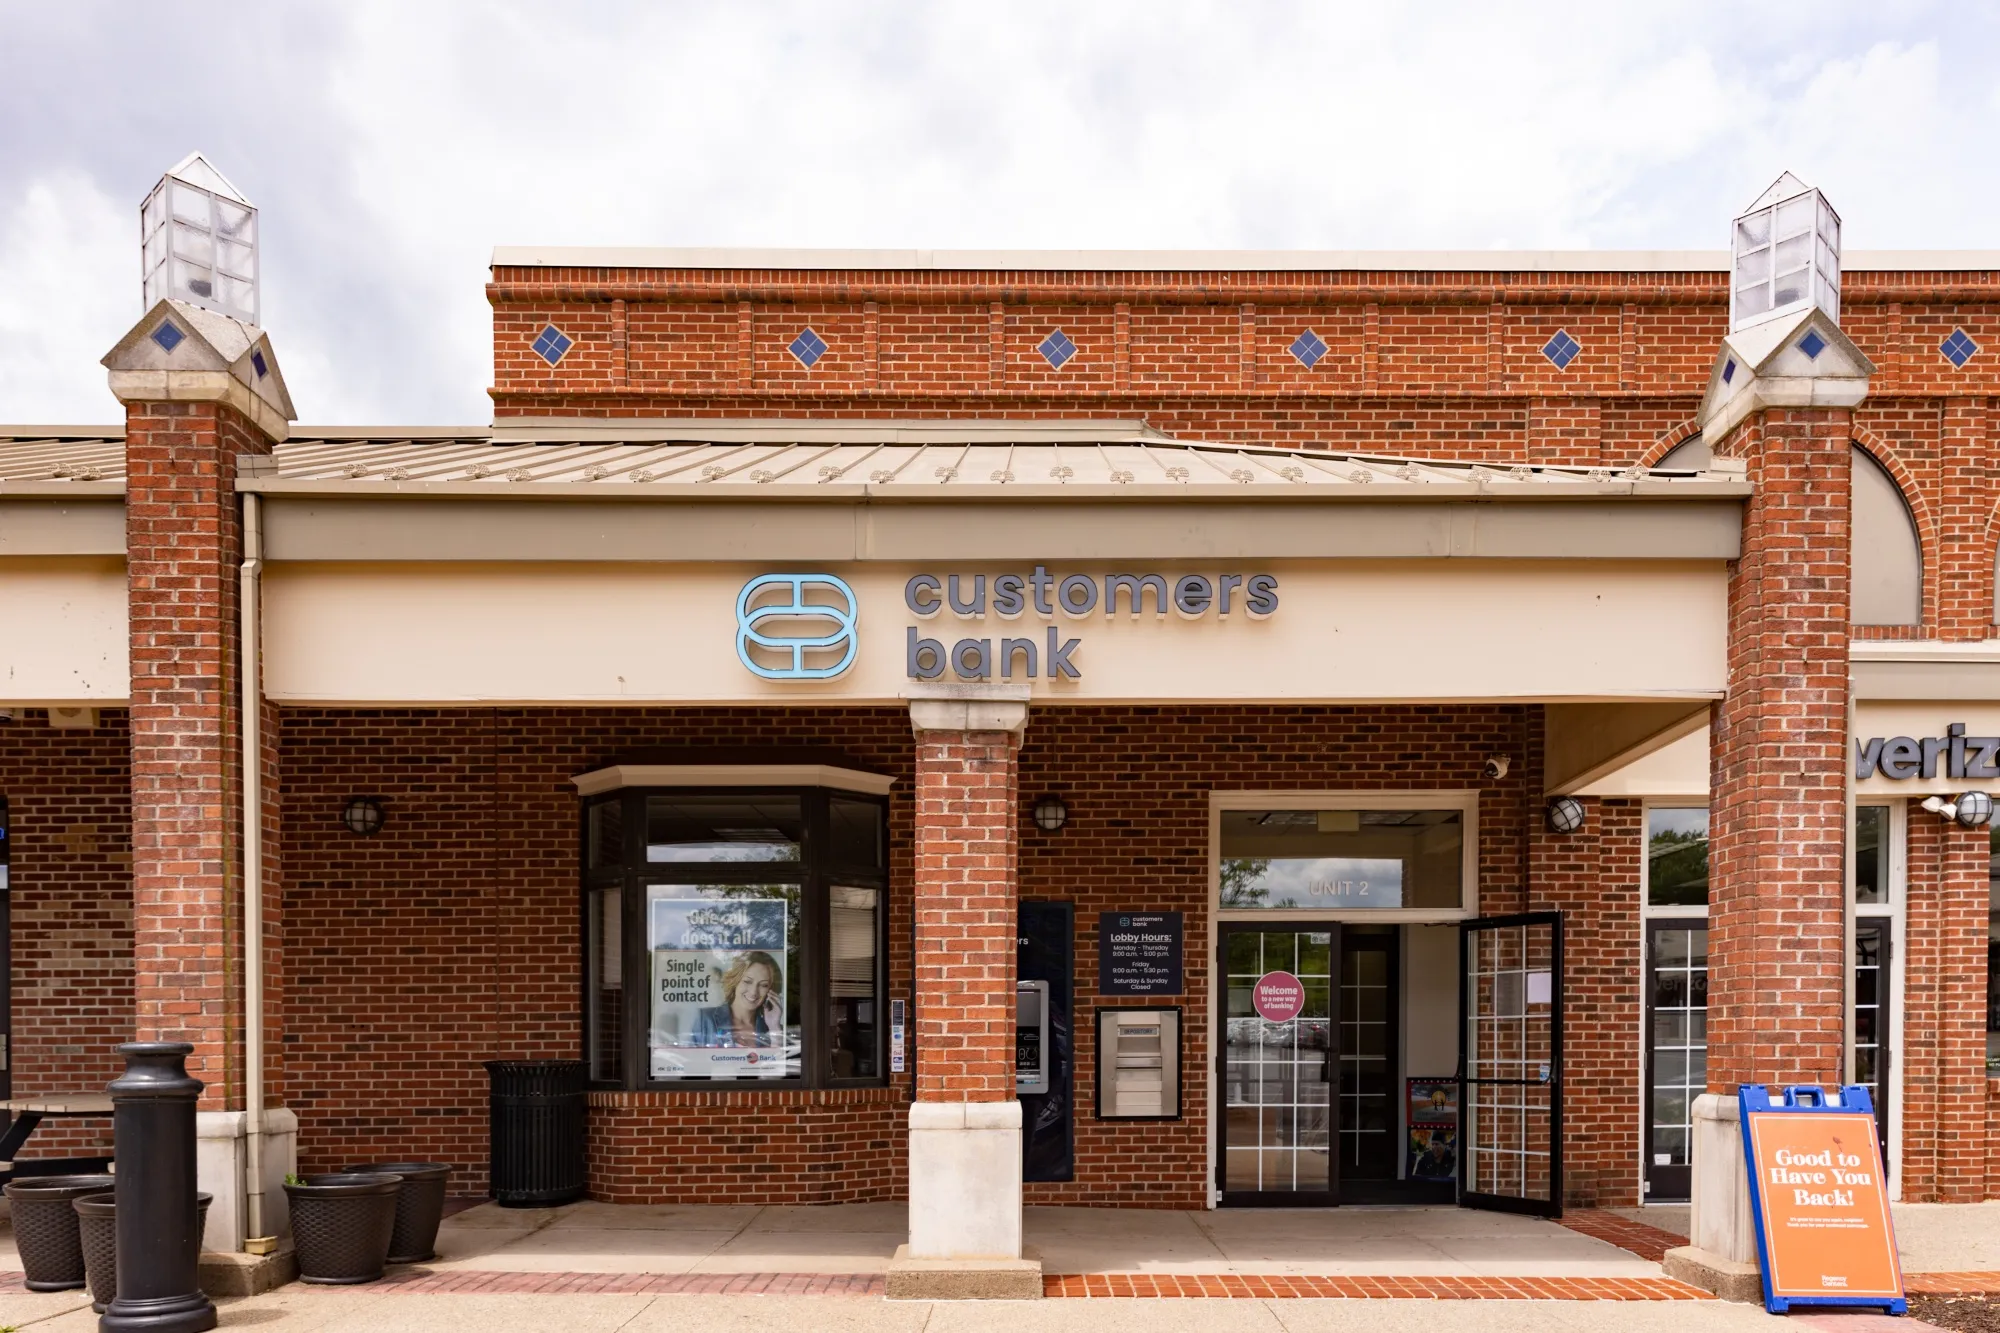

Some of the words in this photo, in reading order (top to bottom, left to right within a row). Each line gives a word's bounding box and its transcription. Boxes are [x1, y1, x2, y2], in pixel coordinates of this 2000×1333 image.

[904, 566, 1279, 619] customers
[906, 626, 1082, 680] bank
[1856, 723, 2000, 779] veriz
[1310, 881, 1353, 896] UNIT
[1359, 881, 1369, 896] 2
[690, 909, 718, 925] One
[720, 908, 748, 925] call
[681, 930, 714, 944] does
[718, 931, 729, 944] it
[733, 930, 756, 945] all.
[1110, 933, 1139, 943] Lobby
[1142, 933, 1172, 942] Hours:
[666, 960, 705, 975] Single
[662, 976, 694, 991] point
[697, 975, 711, 988] of
[1260, 986, 1298, 995] Welcome
[662, 991, 708, 1002] contact
[1775, 1150, 1832, 1166] Good
[1838, 1152, 1860, 1167] to
[1769, 1168, 1826, 1184] Have
[1830, 1168, 1872, 1185] You
[1793, 1189, 1854, 1206] Back!
